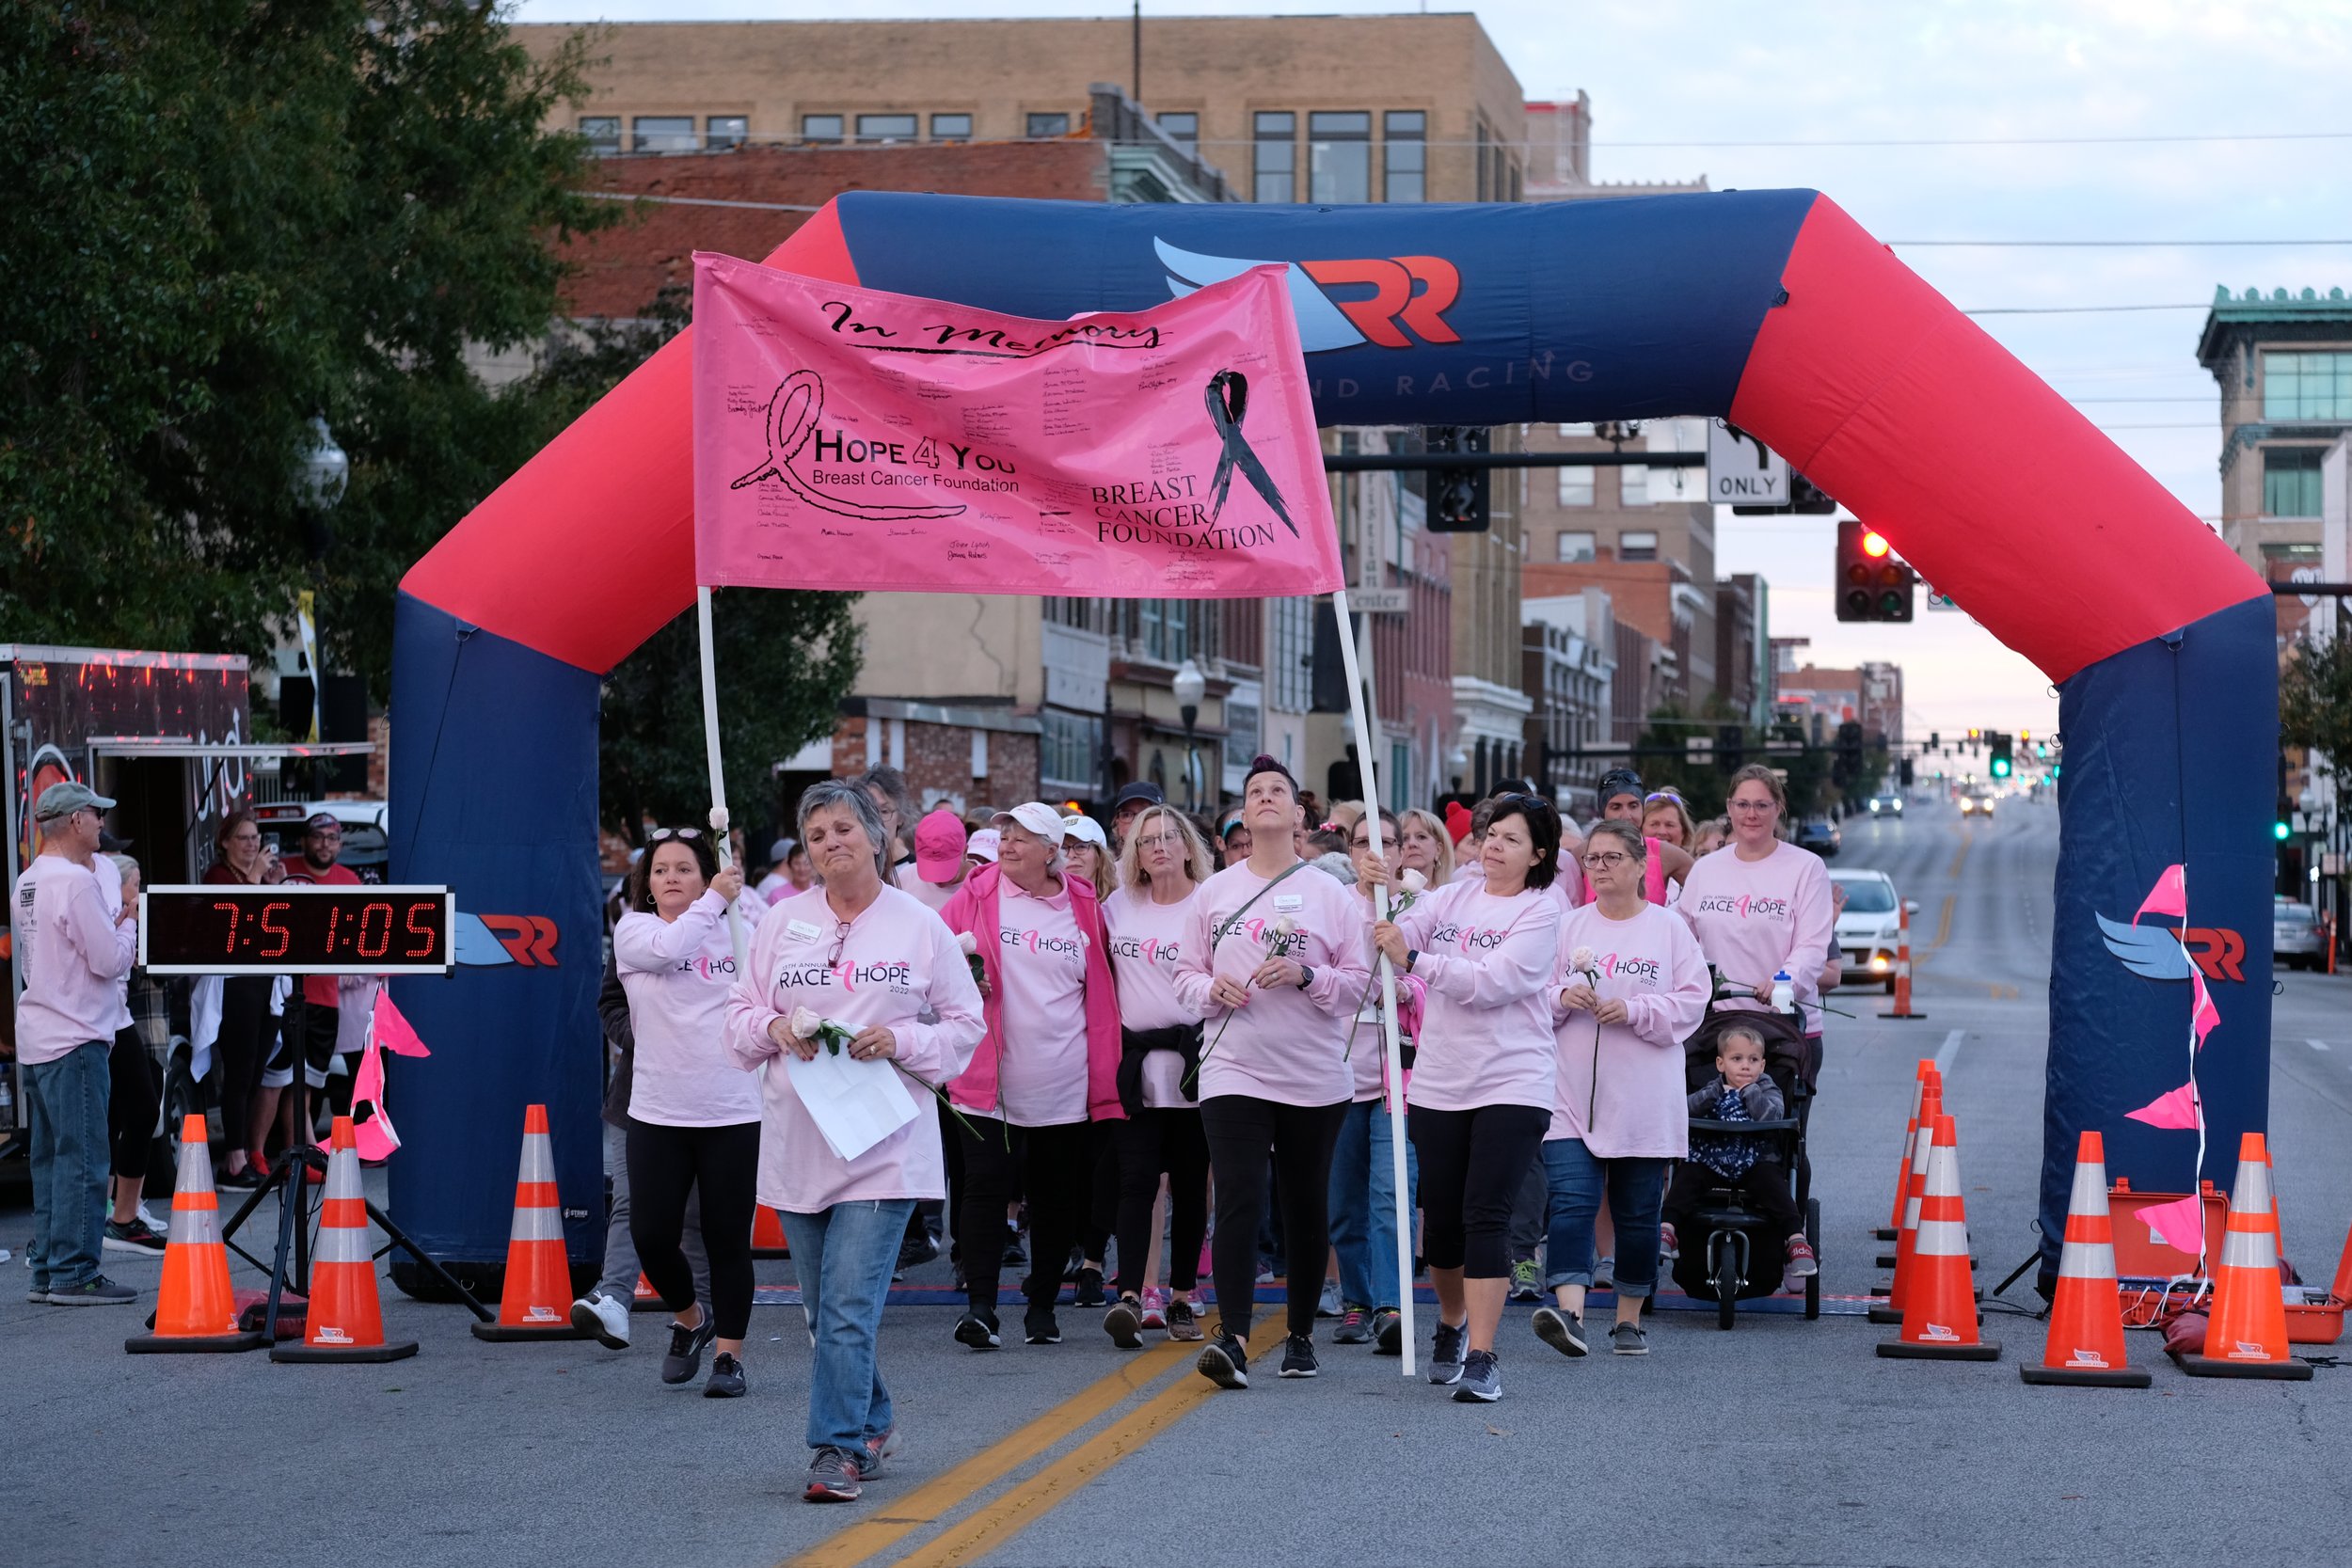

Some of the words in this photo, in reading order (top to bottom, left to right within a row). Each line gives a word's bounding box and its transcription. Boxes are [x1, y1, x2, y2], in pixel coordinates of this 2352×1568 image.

[821, 301, 898, 338] In
[922, 323, 1175, 352] Memory
[1396, 350, 1595, 396] RACING
[913, 436, 940, 469] 4
[813, 470, 865, 485] Breast
[871, 470, 928, 487] Cancer
[933, 474, 1019, 493] Foundation
[1092, 475, 1197, 505] BREAST
[1720, 477, 1776, 496] ONLY
[1095, 503, 1211, 529] CANCER
[1097, 522, 1276, 550] FOUNDATION
[1699, 900, 1734, 913] RACE
[1748, 901, 1787, 915] HOPE
[1212, 922, 1246, 940] RCE
[1470, 932, 1502, 949] HOP
[1000, 931, 1021, 945] CE
[1039, 939, 1079, 958] HOPE
[1156, 946, 1179, 960] HO
[1287, 950, 1306, 958] 2022
[710, 960, 736, 974] HO
[1615, 961, 1659, 980] HOPE
[779, 969, 832, 990] RACE
[855, 967, 910, 986] HOPE
[1640, 977, 1657, 987] 2022
[890, 985, 910, 994] 2022
